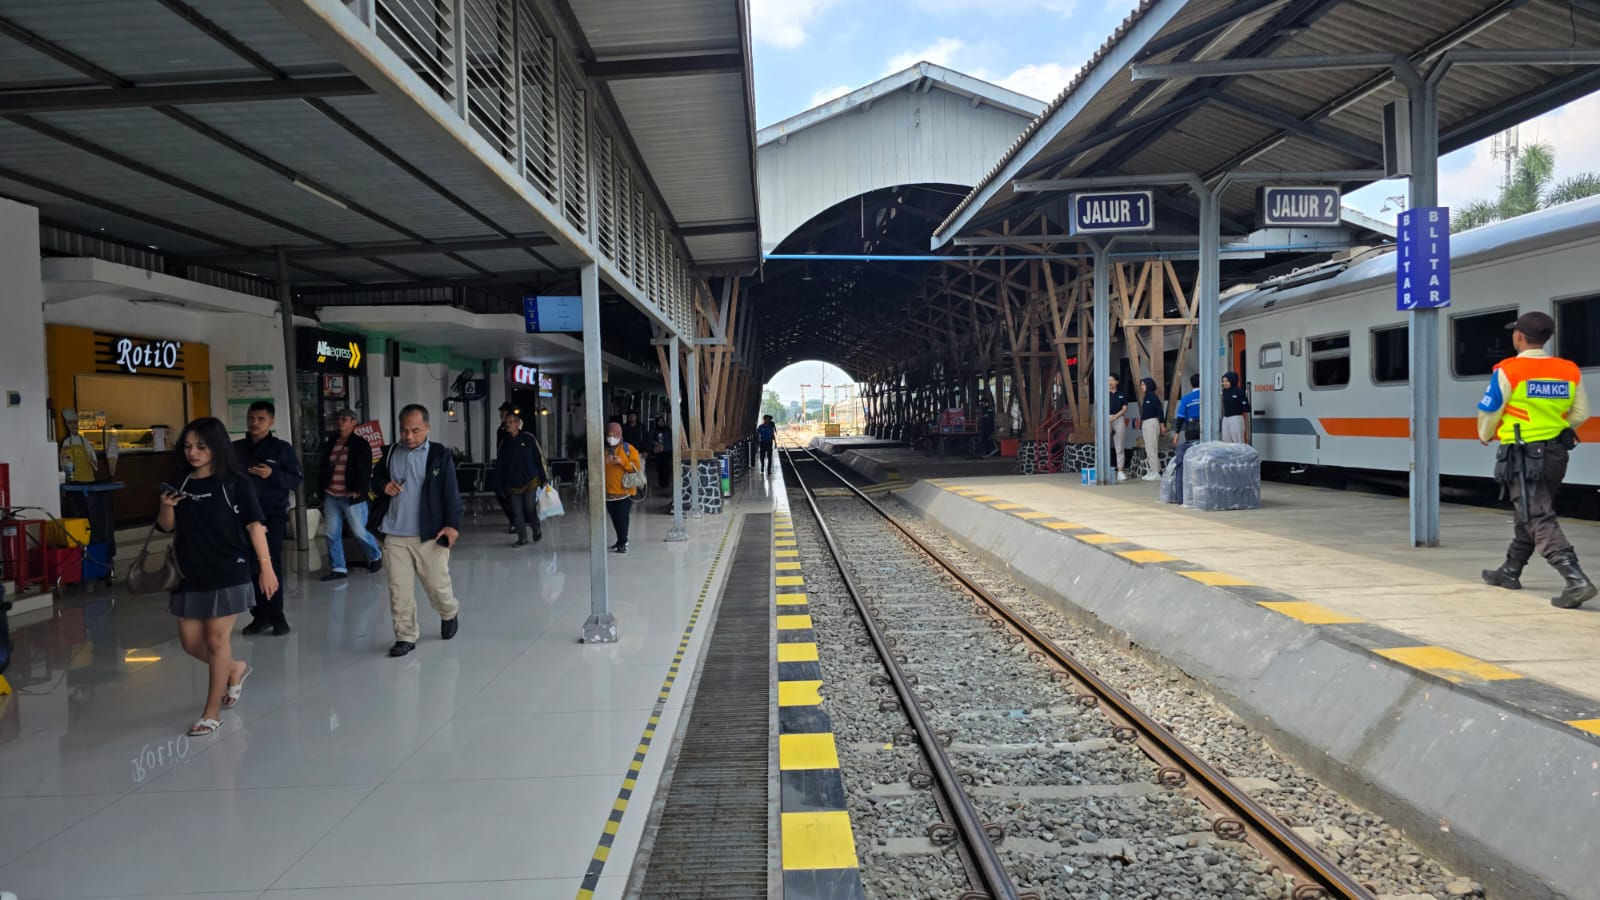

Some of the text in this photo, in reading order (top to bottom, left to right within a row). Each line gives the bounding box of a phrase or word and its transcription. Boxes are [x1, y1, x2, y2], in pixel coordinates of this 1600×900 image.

[1082, 198, 1145, 224] JALUR 1
[1272, 194, 1333, 218] JALUR 2
[1403, 214, 1411, 305] BLITAR
[1429, 211, 1440, 302] BLITAR
[515, 364, 536, 385] CFC
[1529, 383, 1568, 395] PAM KCI
